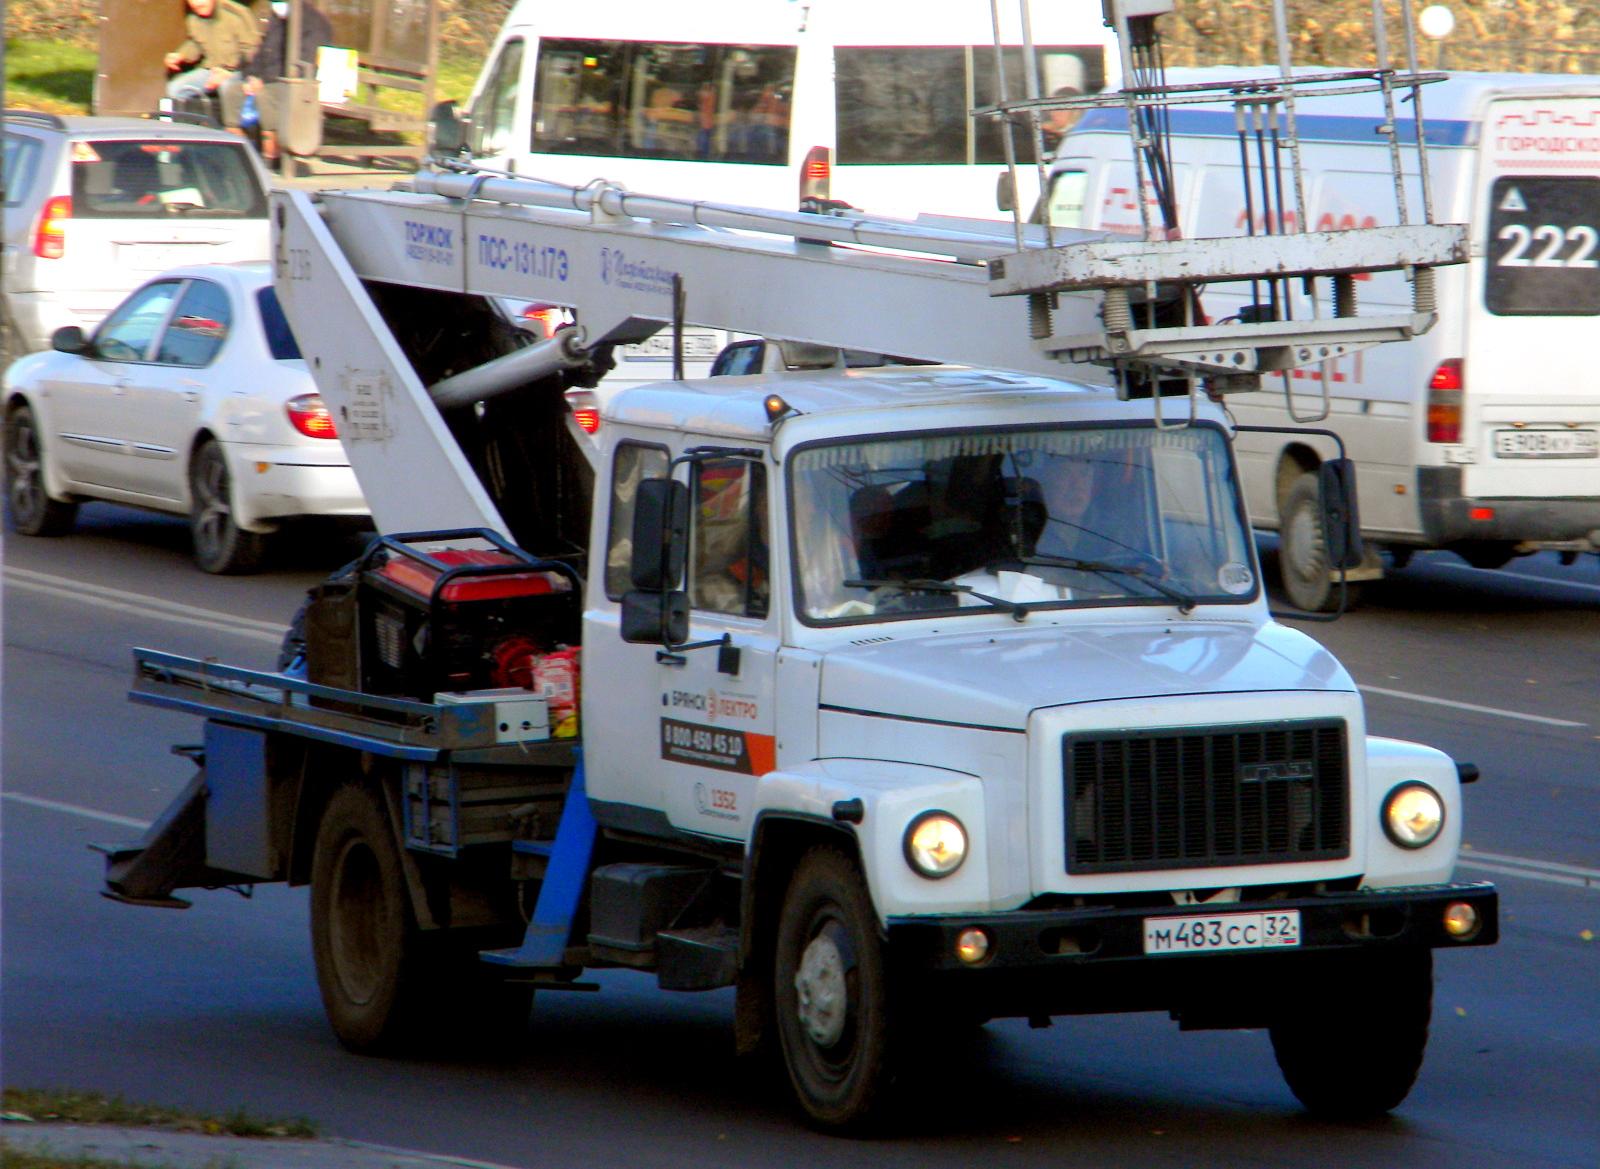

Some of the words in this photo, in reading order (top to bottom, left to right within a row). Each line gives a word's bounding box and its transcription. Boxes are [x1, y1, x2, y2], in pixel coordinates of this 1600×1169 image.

[404, 221, 453, 249] ТОРЖОК
[1497, 224, 1600, 268] 222
[478, 234, 569, 282] ПСС-131.17Э
[664, 724, 672, 743] 8
[673, 726, 692, 748] 800
[693, 729, 712, 751] 450
[713, 733, 727, 754] 45
[728, 735, 743, 756] 10
[1155, 920, 1257, 950] М483СС
[1265, 915, 1291, 936] 32
